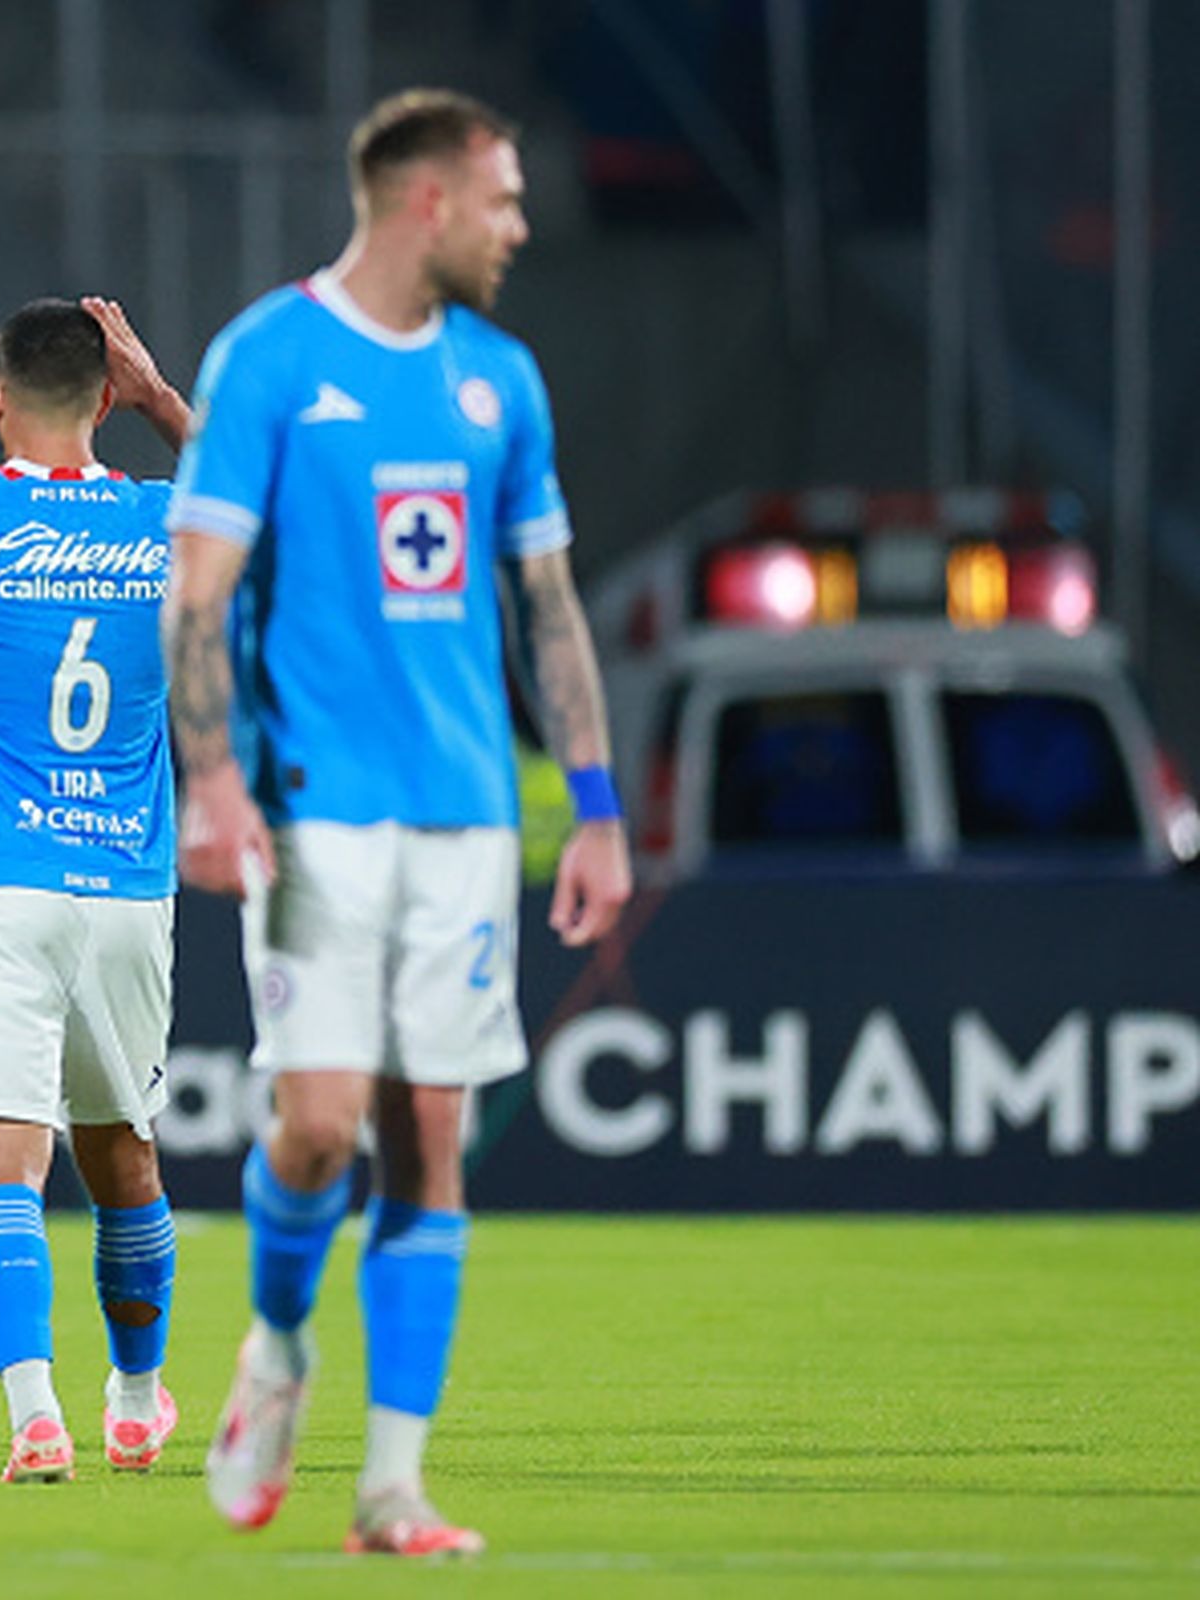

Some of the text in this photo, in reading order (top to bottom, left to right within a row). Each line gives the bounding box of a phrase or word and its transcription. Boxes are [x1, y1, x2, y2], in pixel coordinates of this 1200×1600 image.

[49, 617, 111, 753] 6
[50, 768, 107, 798] LIRA
[538, 1006, 1200, 1156] CHAMP
